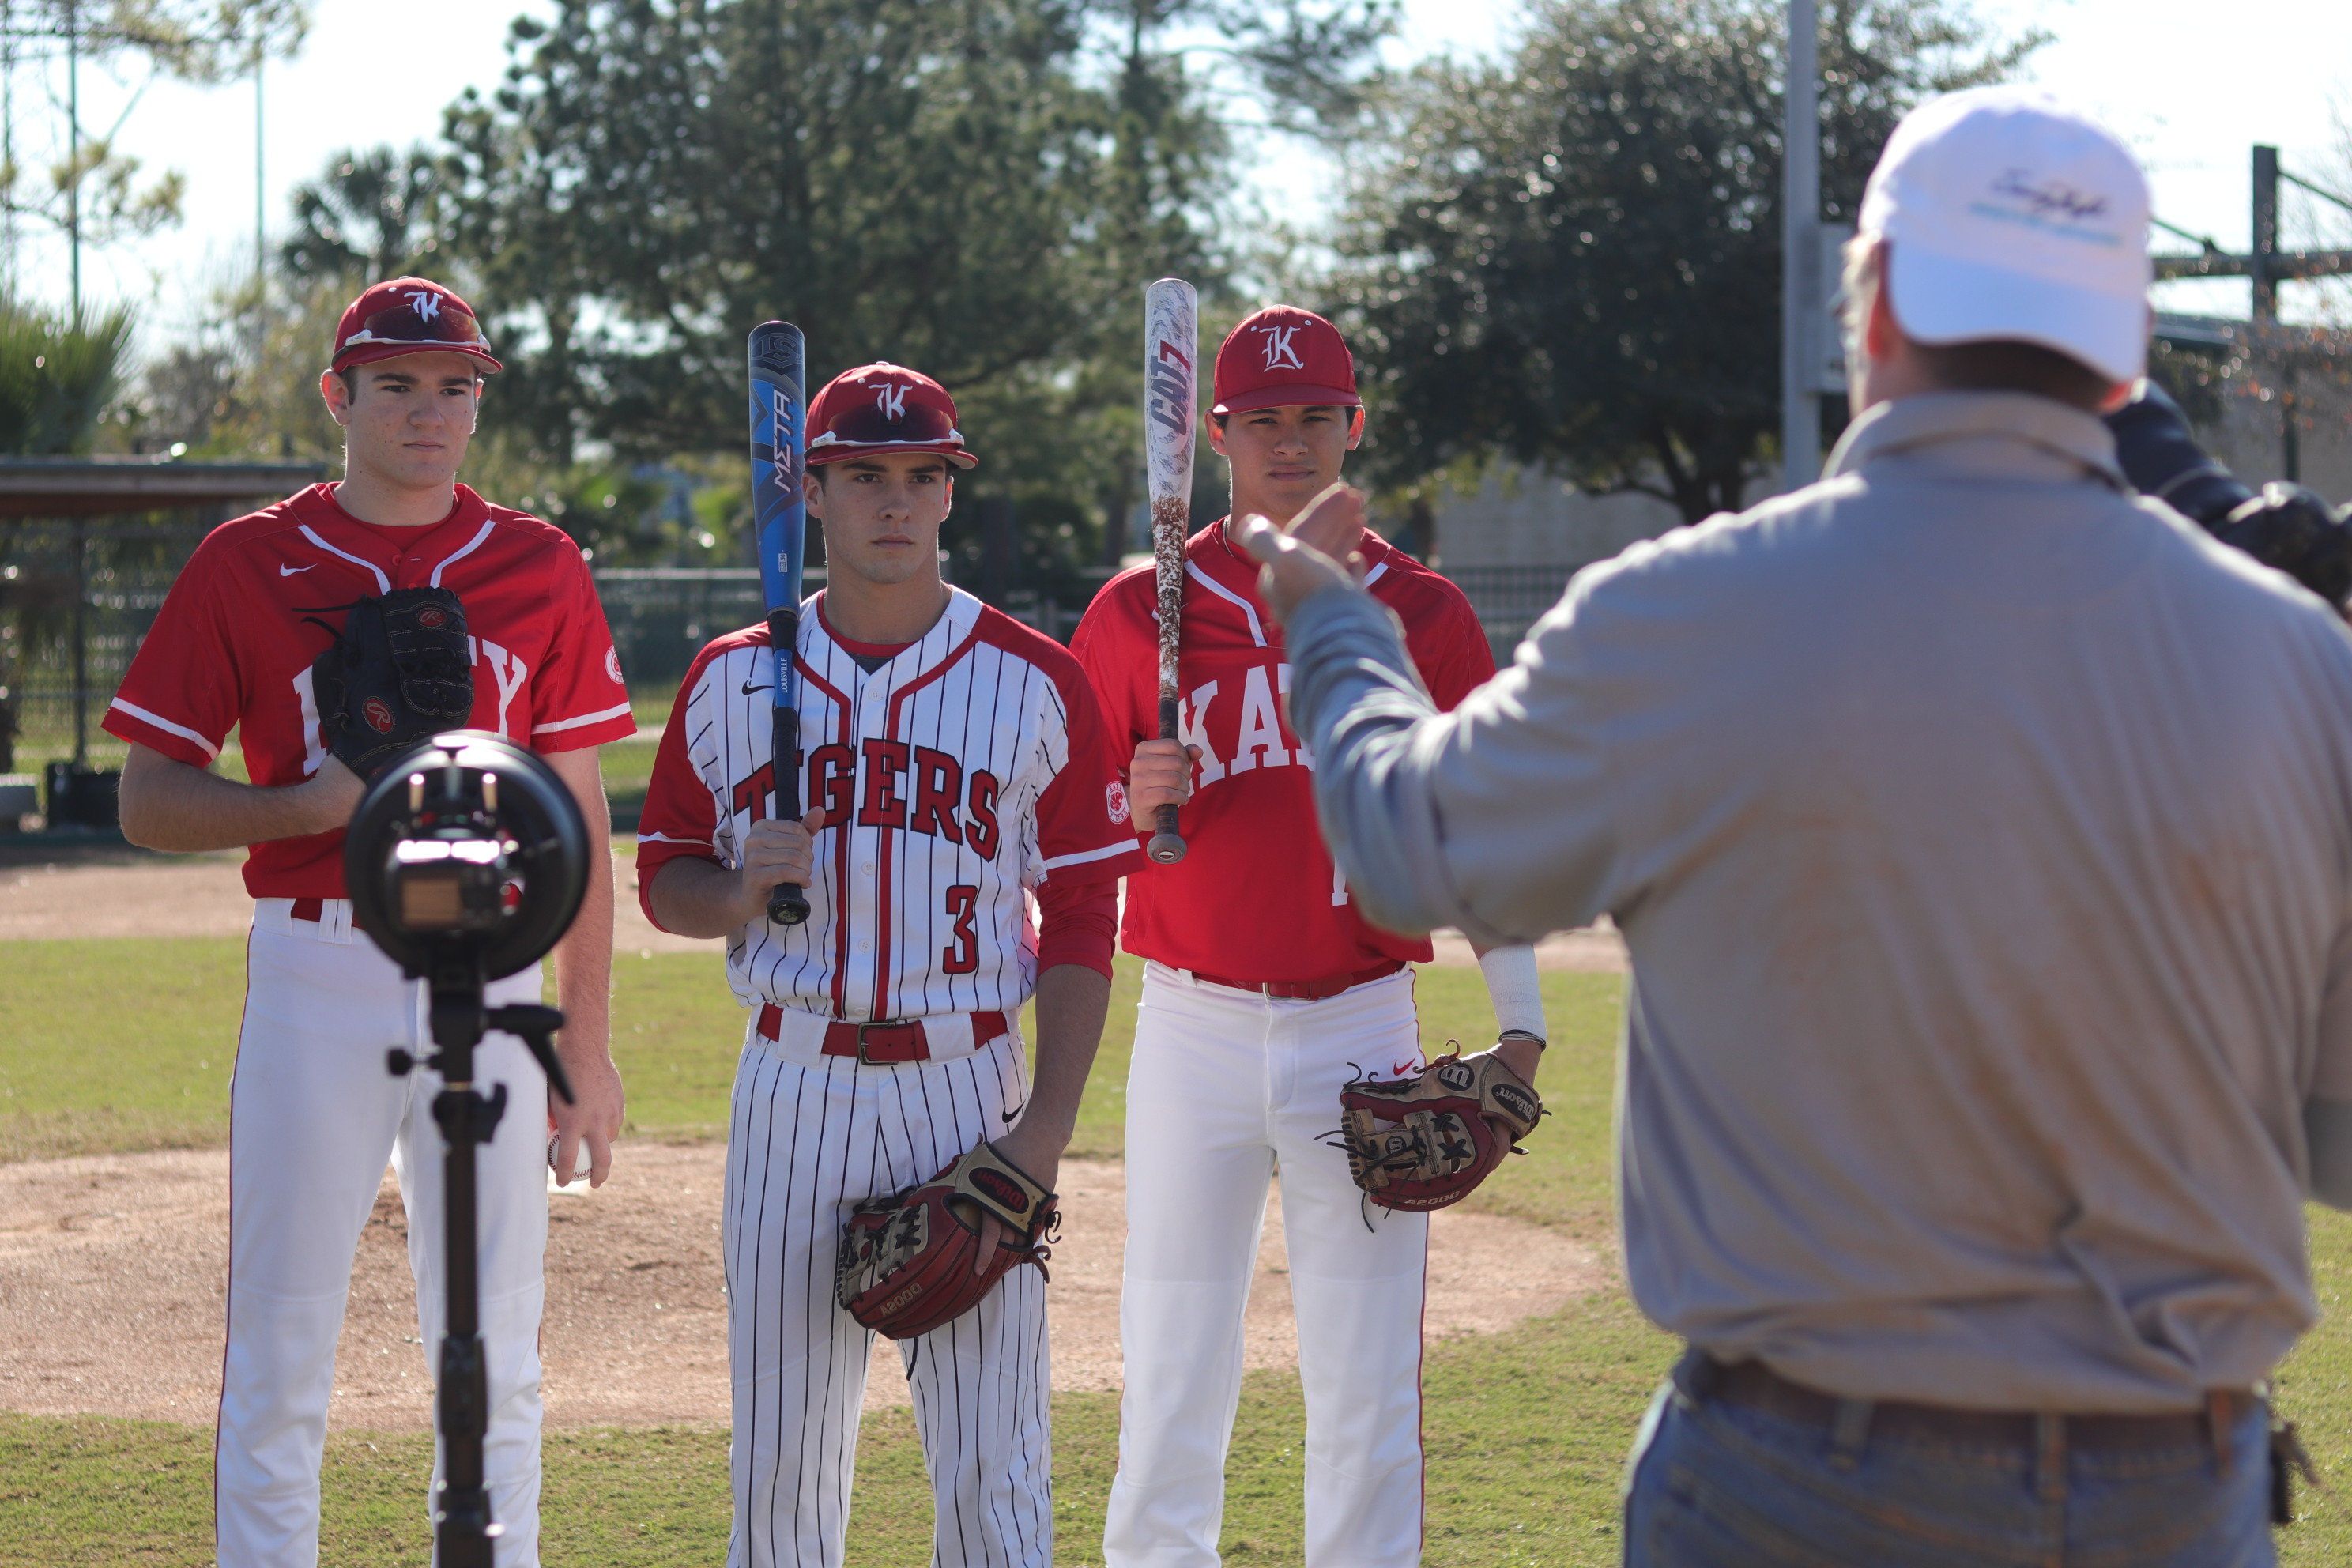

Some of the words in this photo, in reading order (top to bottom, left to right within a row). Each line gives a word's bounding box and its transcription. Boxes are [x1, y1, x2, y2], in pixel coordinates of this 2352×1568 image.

[1151, 339, 1191, 435] CAT7
[943, 884, 978, 974] 3
[1498, 1087, 1534, 1121] Wilson
[1404, 1190, 1461, 1205] A2000
[879, 1282, 922, 1317] A2000
